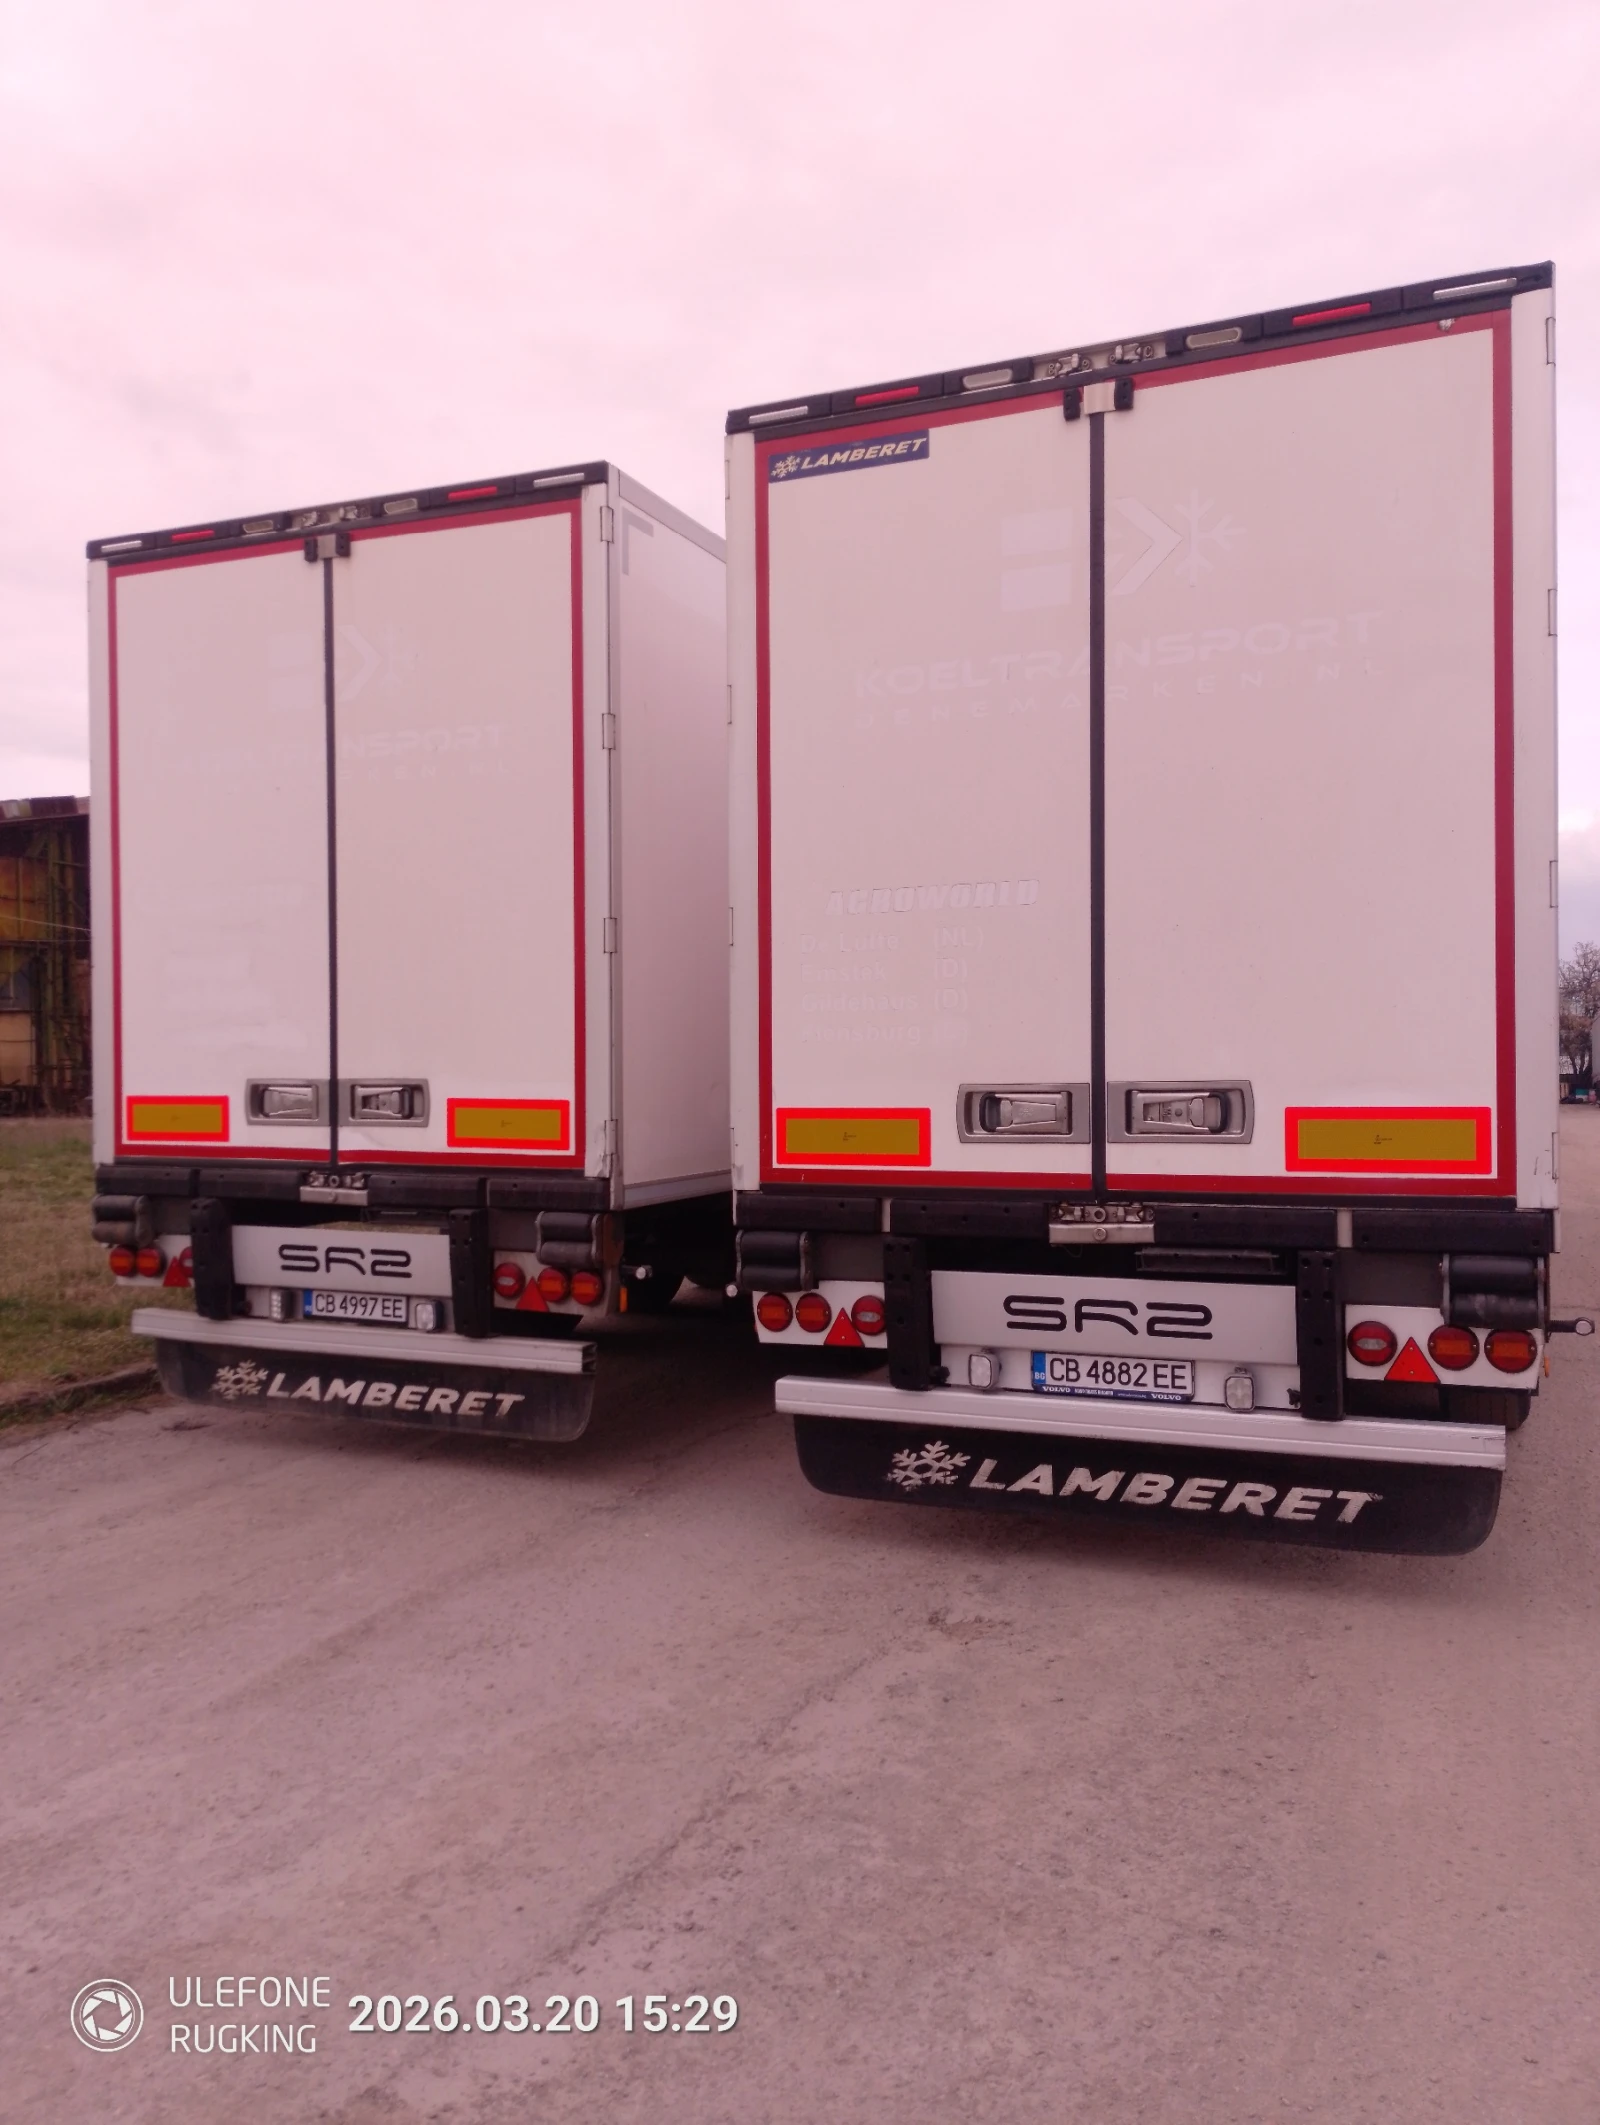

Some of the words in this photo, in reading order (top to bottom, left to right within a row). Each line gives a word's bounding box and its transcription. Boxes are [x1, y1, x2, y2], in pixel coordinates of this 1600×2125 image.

[801, 438, 927, 470] LAMBERET
[279, 1244, 412, 1278] SR2
[315, 1294, 335, 1313] CB
[340, 1295, 379, 1316] 4997
[382, 1298, 403, 1318] EE
[1003, 1295, 1213, 1340] SR2
[1034, 1371, 1046, 1380] BG
[1050, 1357, 1081, 1382] CB
[1086, 1360, 1148, 1387] 4882
[1153, 1363, 1188, 1390] EE
[266, 1372, 525, 1417] LAMBERET
[1151, 1393, 1182, 1401] VOLVO
[969, 1458, 1379, 1524] LAMBERET
